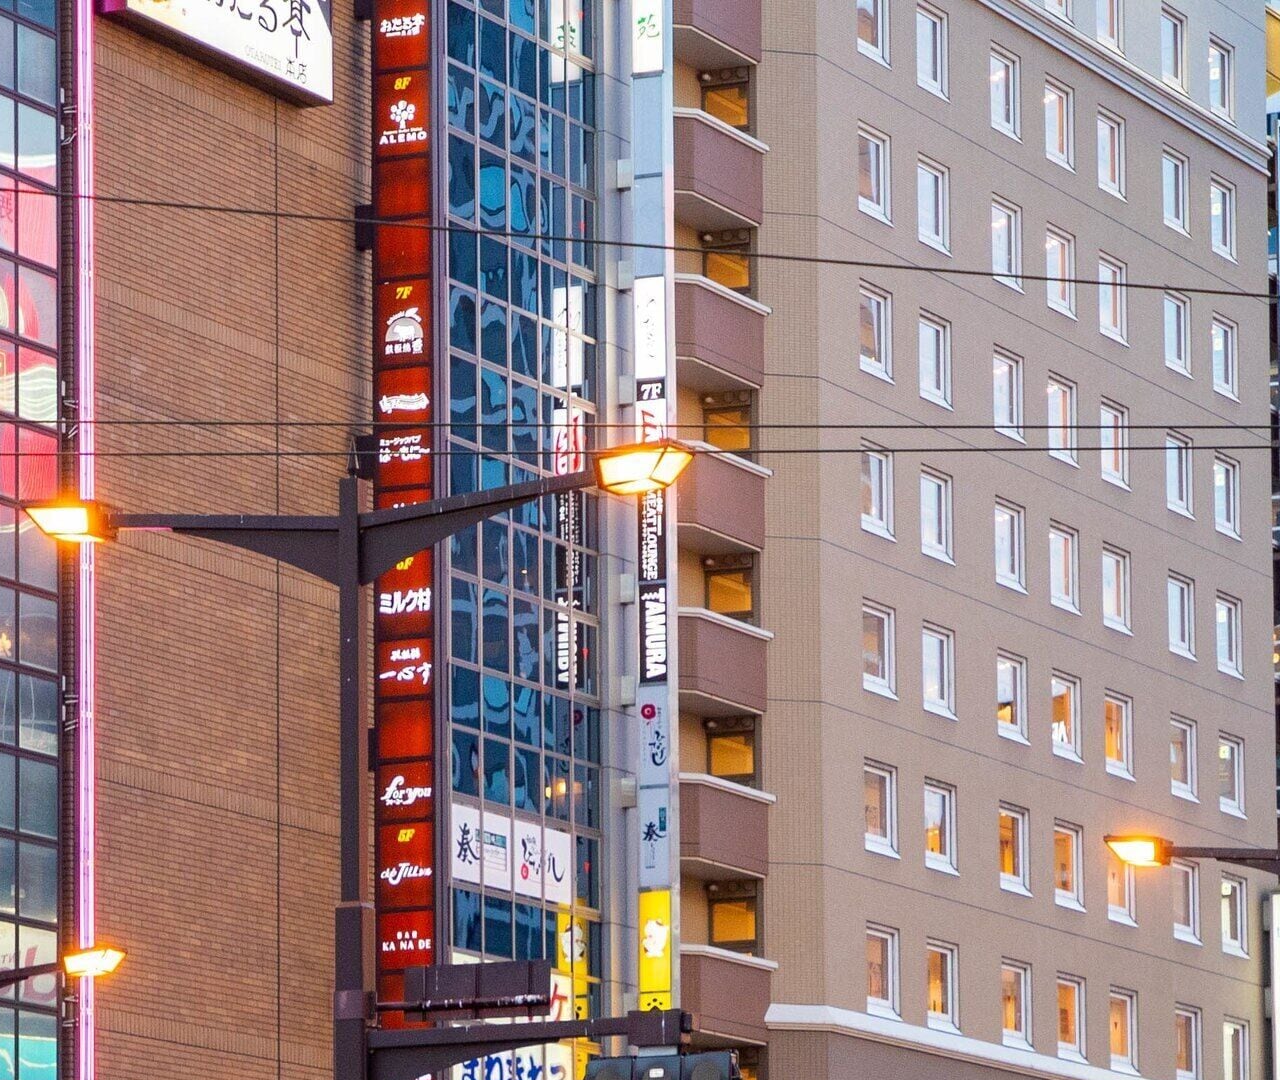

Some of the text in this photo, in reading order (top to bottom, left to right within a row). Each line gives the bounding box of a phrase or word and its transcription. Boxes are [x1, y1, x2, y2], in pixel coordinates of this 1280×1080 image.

[394, 77, 411, 90] 8F
[379, 131, 427, 145] ALEMO
[396, 285, 412, 300] 7F
[641, 382, 662, 400] 7F
[646, 525, 658, 581] LOUNGE
[380, 587, 431, 614] ミルク村
[644, 587, 667, 679] TAMURA
[398, 828, 415, 842] 5F
